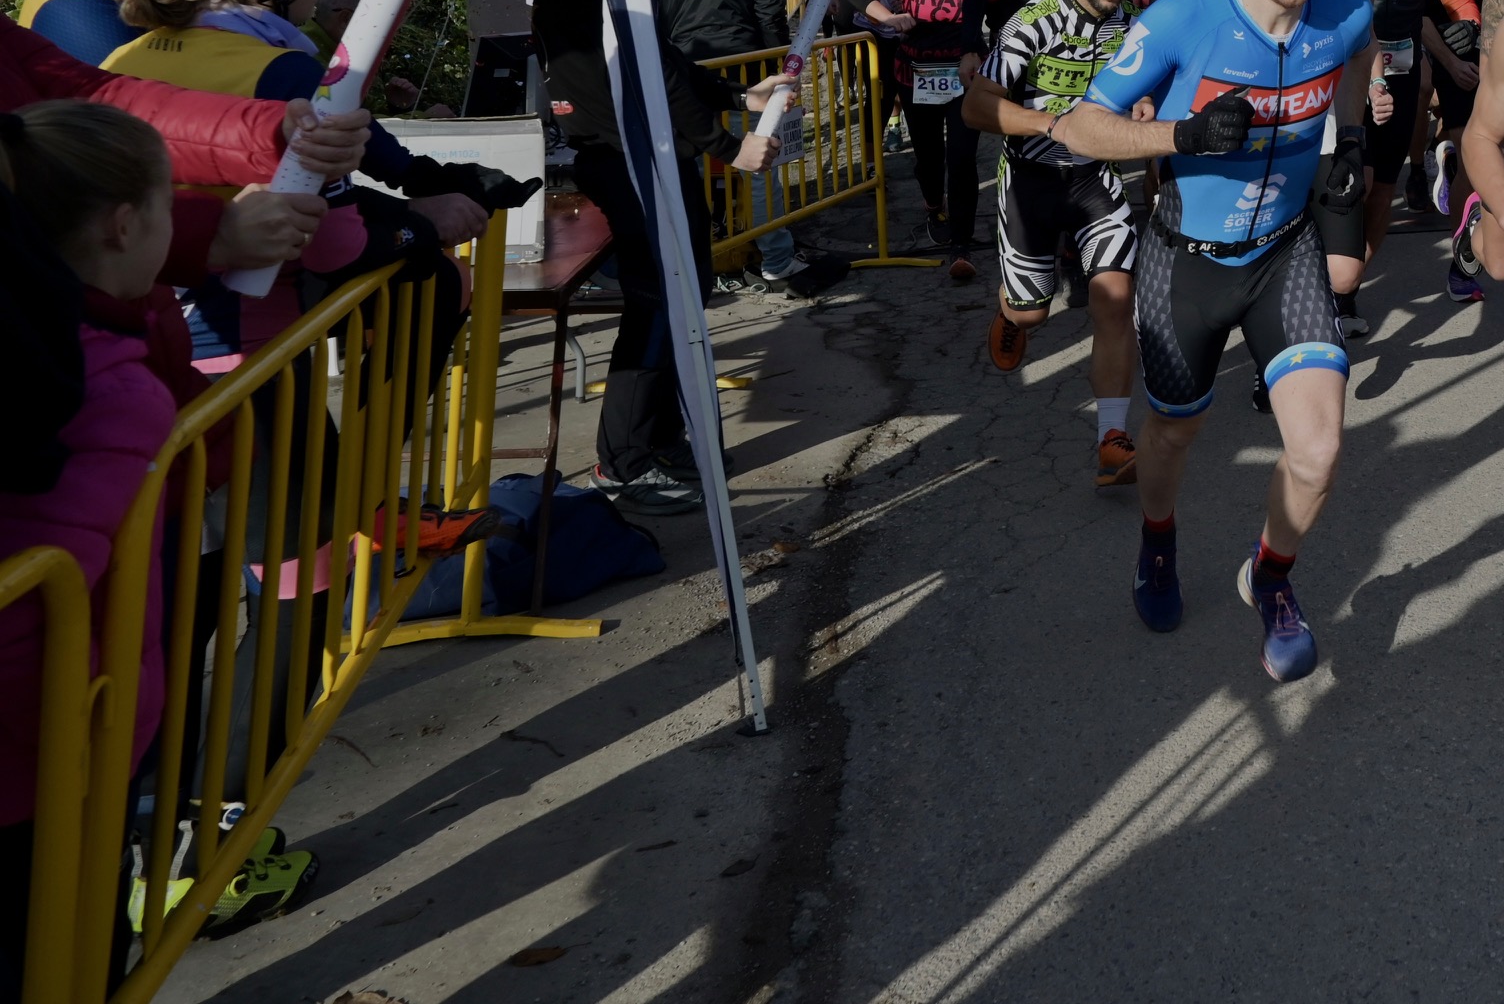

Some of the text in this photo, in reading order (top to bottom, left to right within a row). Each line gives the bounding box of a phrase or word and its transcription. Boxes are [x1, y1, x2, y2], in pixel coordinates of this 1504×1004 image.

[1314, 35, 1334, 51] pyxis
[787, 60, 799, 69] 80
[1383, 53, 1392, 66] 3
[918, 77, 949, 90] 218
